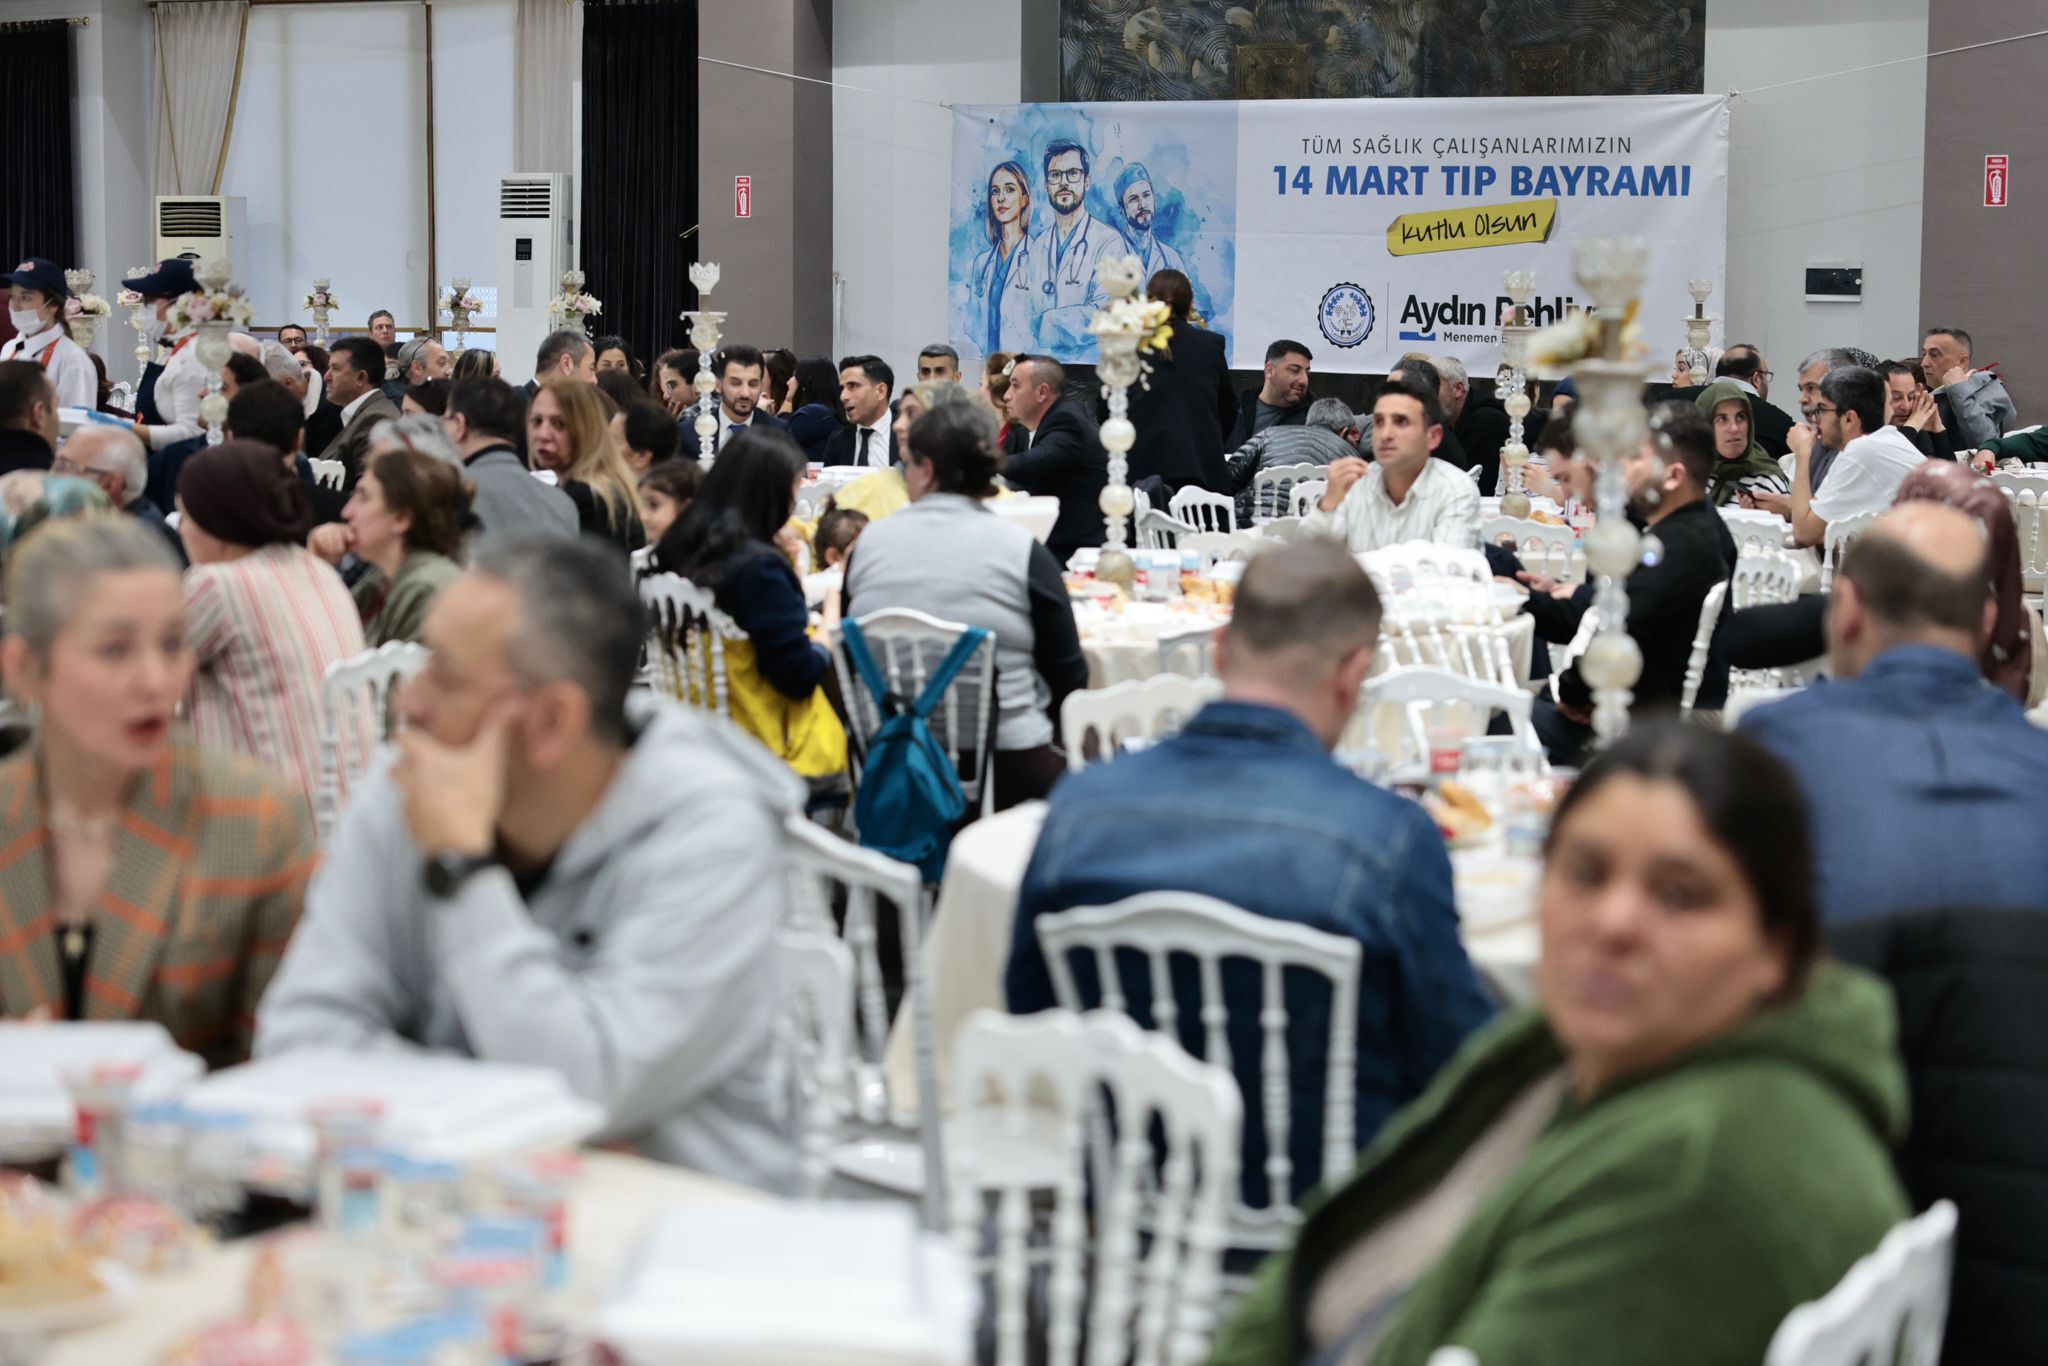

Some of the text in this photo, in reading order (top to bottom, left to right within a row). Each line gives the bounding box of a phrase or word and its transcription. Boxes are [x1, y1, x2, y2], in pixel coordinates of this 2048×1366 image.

[1302, 134, 1631, 159] TÜM SAĞLIK ÇALIŞANLARIMIZIN
[1273, 165, 1691, 197] 14 MART TIP BAYRAMI
[1475, 212, 1536, 236] Olsun
[1400, 294, 1486, 334] Aydın
[1443, 331, 1498, 343] Menemen
